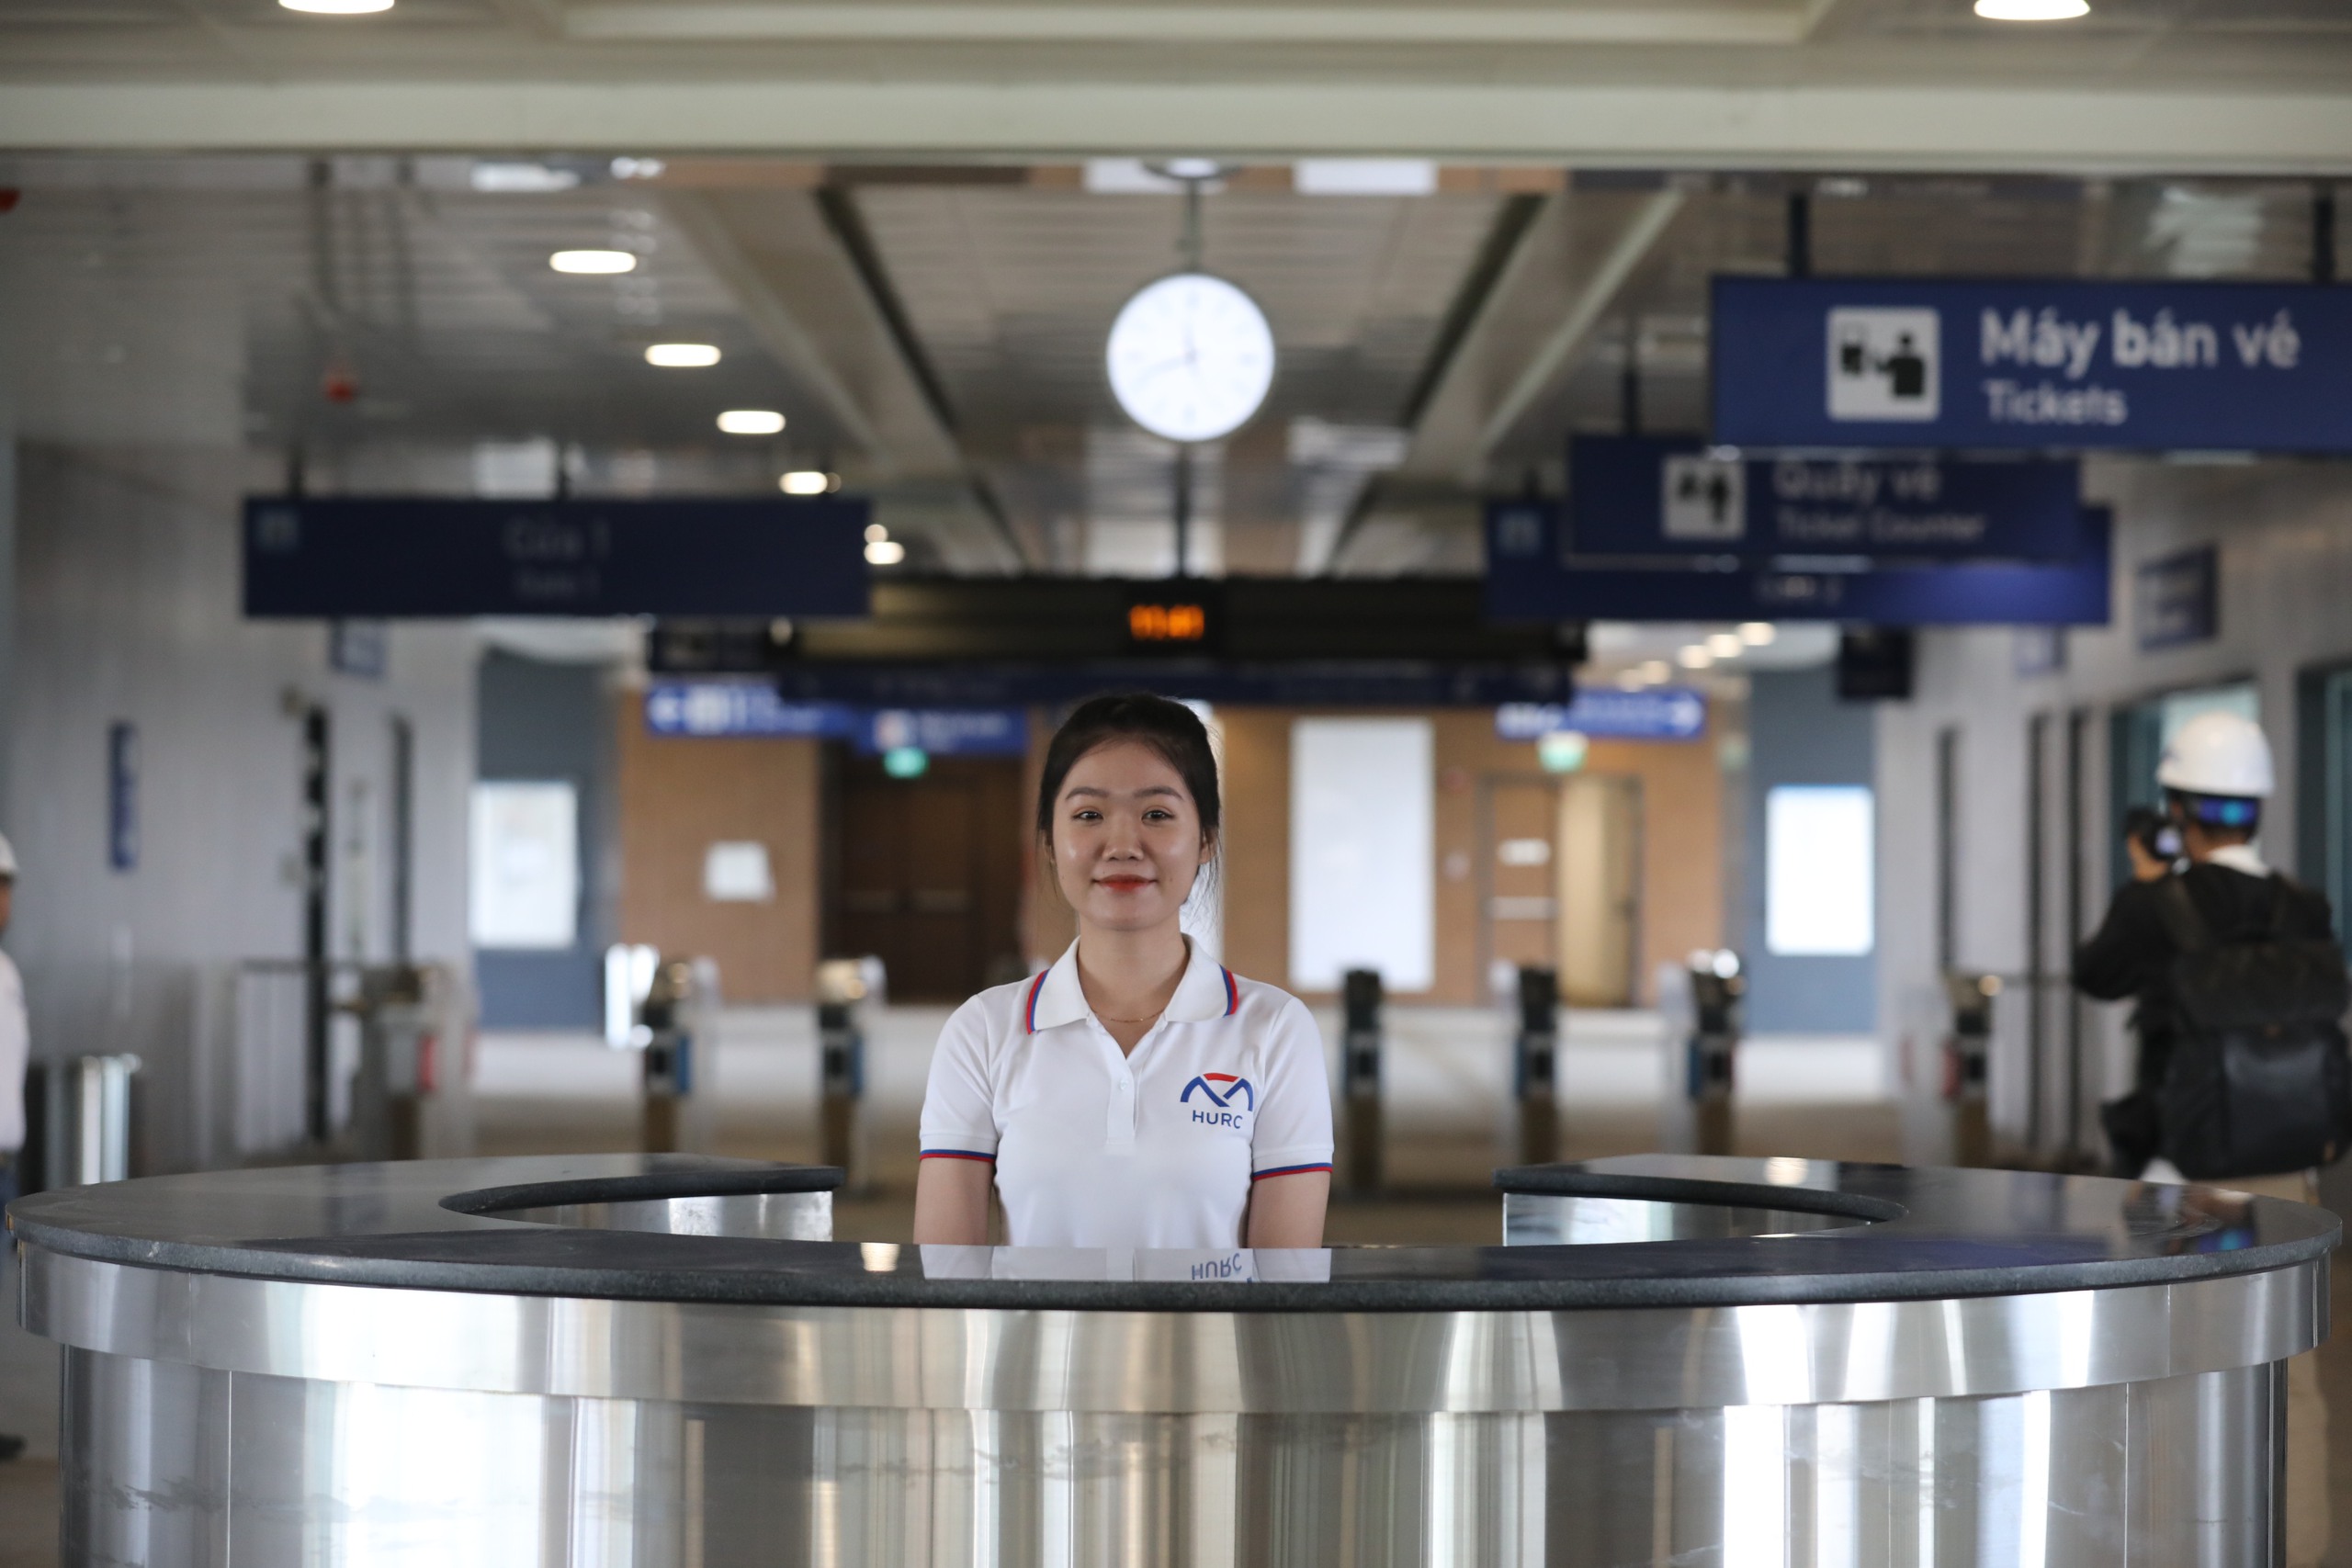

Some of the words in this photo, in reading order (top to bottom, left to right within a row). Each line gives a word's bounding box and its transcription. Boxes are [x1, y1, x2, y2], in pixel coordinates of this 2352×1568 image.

[1982, 307, 2099, 378] Máy
[2113, 308, 2217, 367] bán
[2233, 309, 2301, 367] vé
[1984, 380, 2127, 423] Tickets
[1192, 1110, 1243, 1130] HURC
